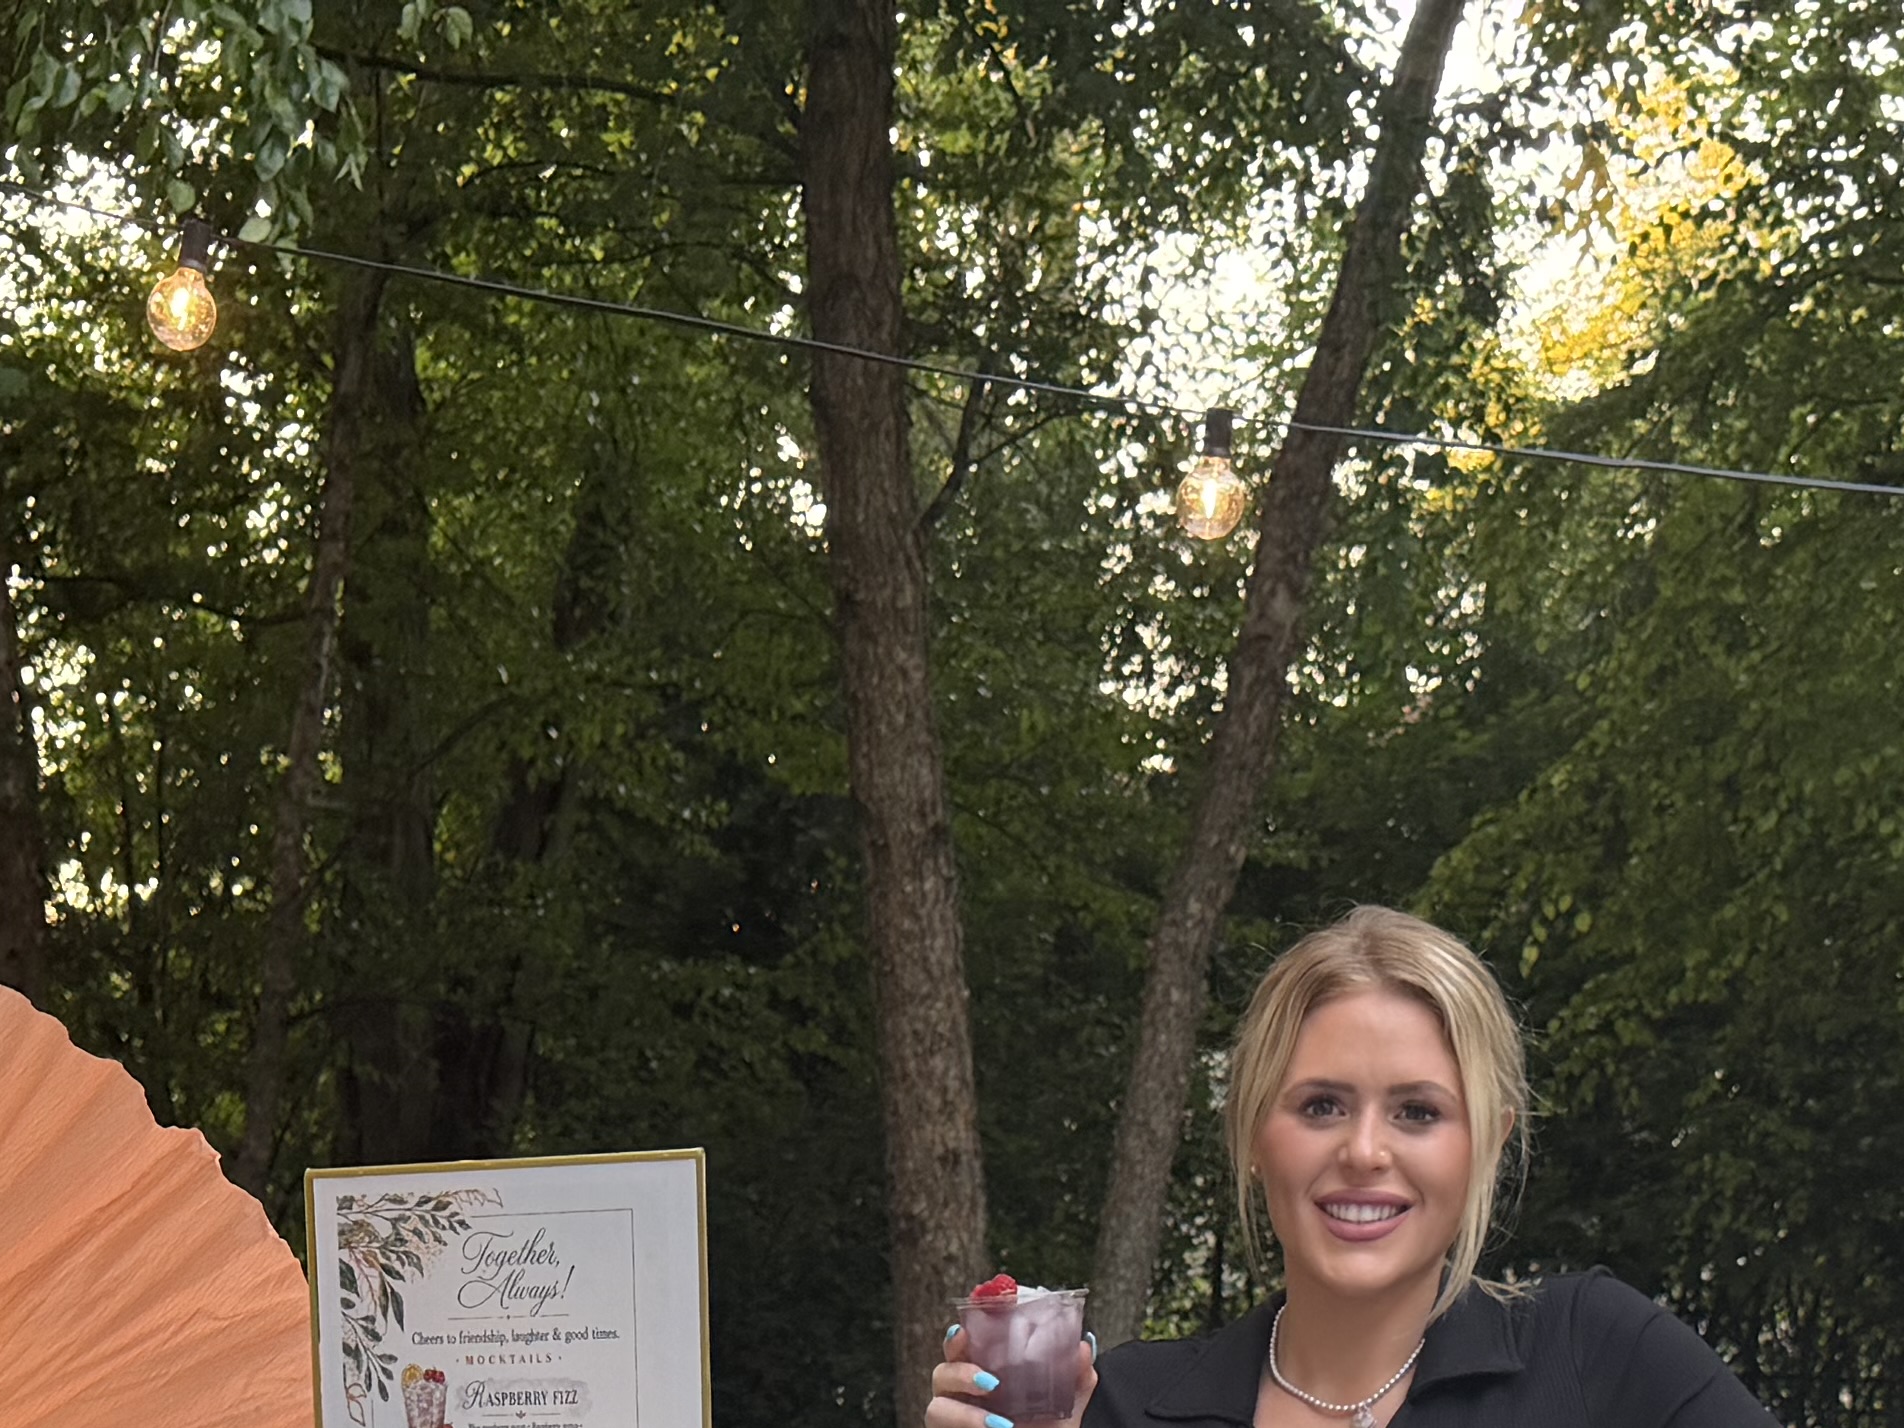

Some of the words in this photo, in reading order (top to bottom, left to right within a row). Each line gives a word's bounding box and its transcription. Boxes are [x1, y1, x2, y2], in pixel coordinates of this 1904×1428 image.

[461, 1228, 560, 1280] Together,
[457, 1265, 575, 1317] Always!
[412, 1332, 444, 1345] Cheers
[446, 1333, 457, 1344] to
[512, 1329, 549, 1345] laughter
[552, 1328, 561, 1341] &
[565, 1327, 588, 1344] good
[465, 1353, 553, 1365] MOCKTAILS
[553, 1389, 579, 1405] FIZZ
